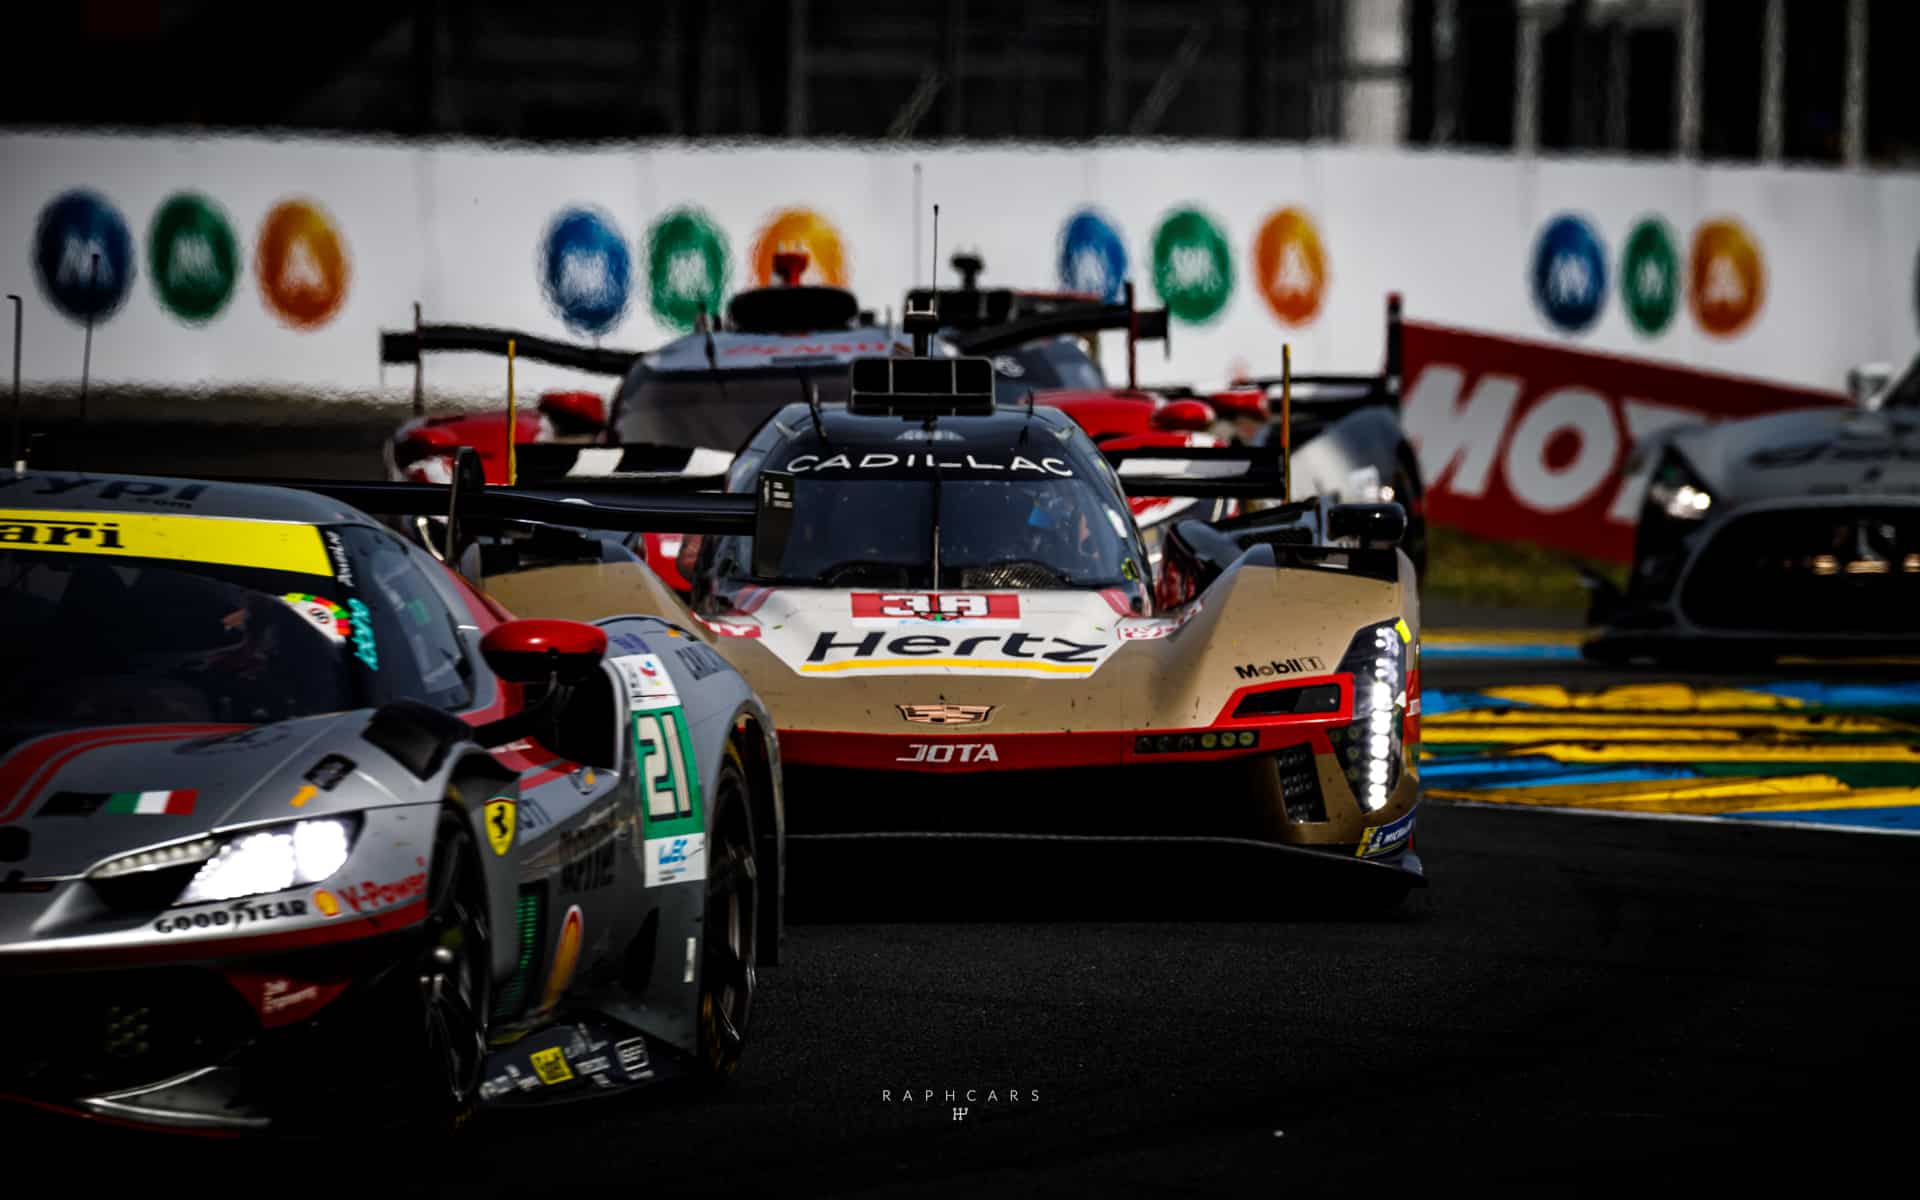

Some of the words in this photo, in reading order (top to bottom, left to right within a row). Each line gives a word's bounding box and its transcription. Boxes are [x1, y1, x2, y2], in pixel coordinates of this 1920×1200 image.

[278, 230, 331, 288] A
[1275, 238, 1315, 296] A
[1703, 248, 1747, 305] A
[785, 452, 1073, 477] CADILLAC
[805, 630, 1108, 662] Hertz
[1234, 658, 1303, 679] Mobil
[636, 712, 692, 821] 21
[896, 743, 999, 764] JOTA
